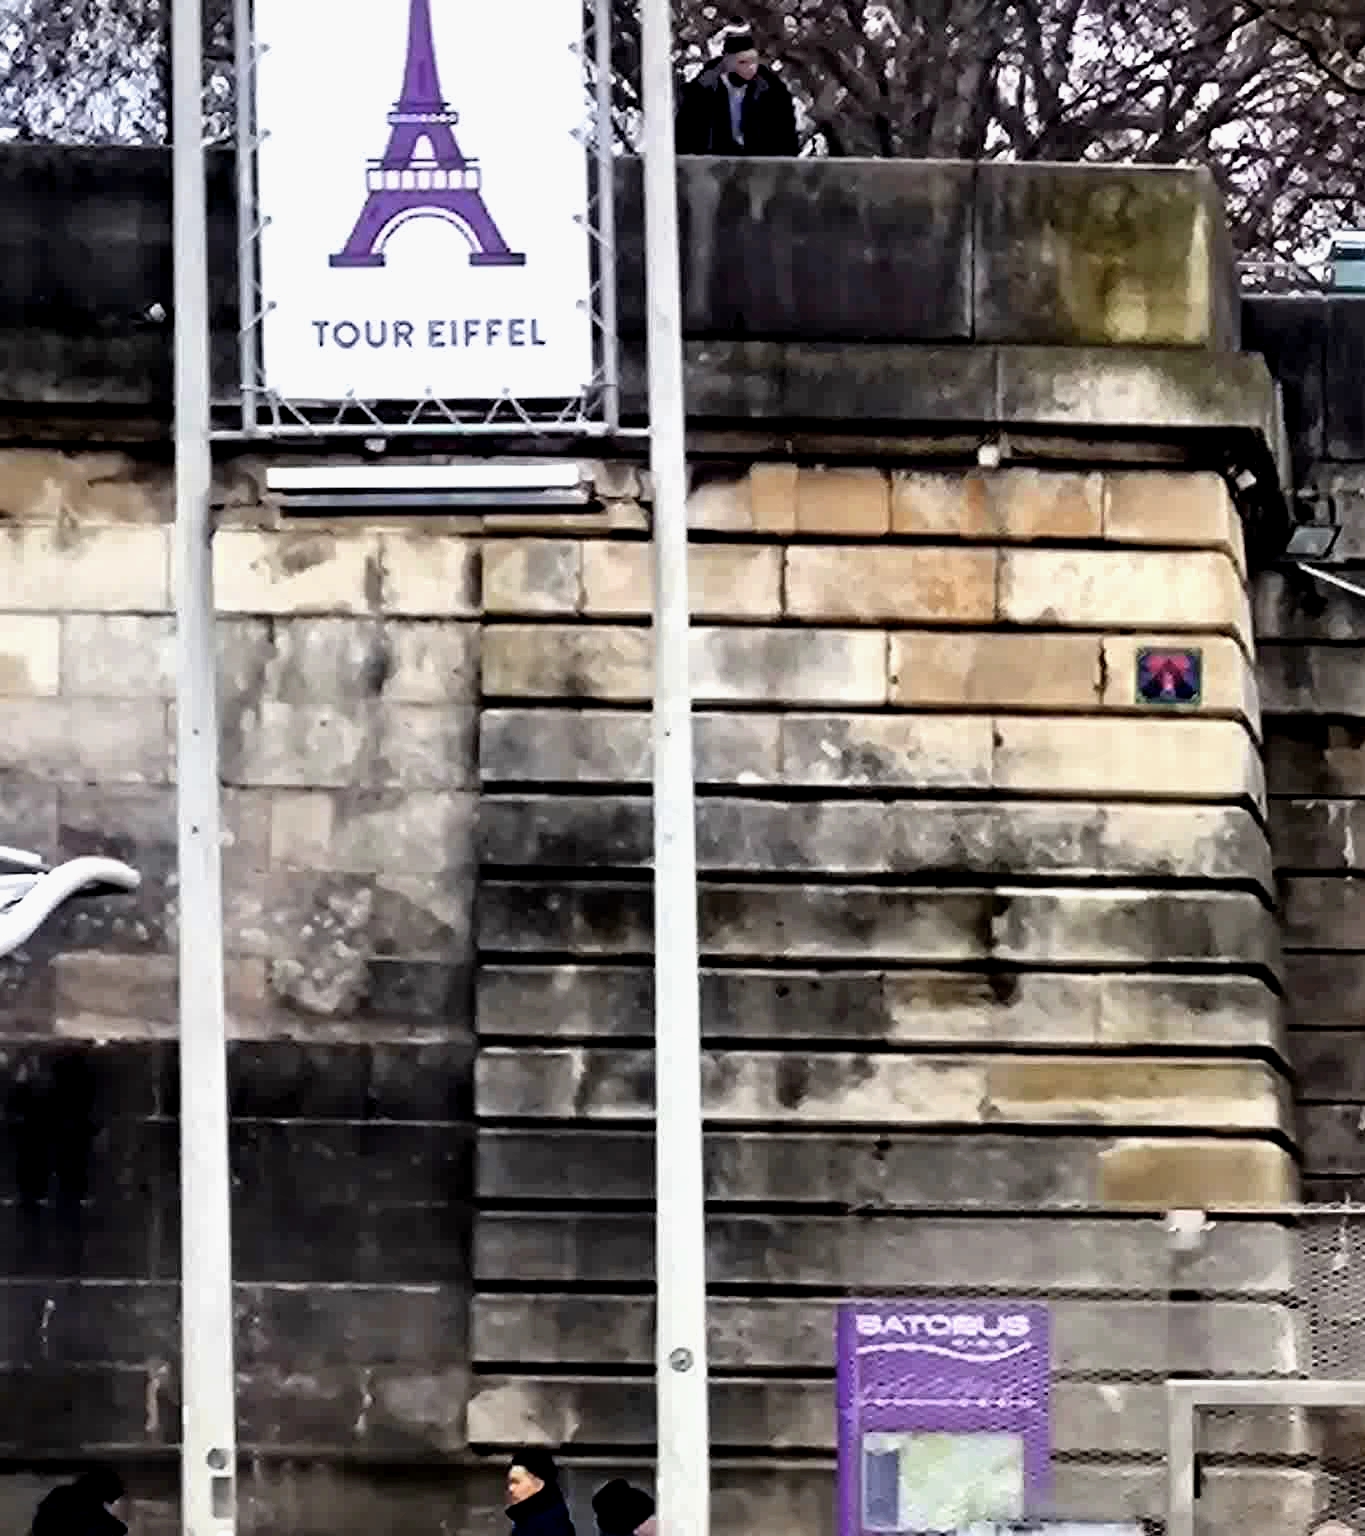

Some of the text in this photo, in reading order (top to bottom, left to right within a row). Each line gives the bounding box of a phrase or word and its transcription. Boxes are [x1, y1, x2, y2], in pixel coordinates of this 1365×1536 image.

[311, 318, 547, 349] TOUR EIFFEL
[855, 1314, 1032, 1337] BATOBUS
